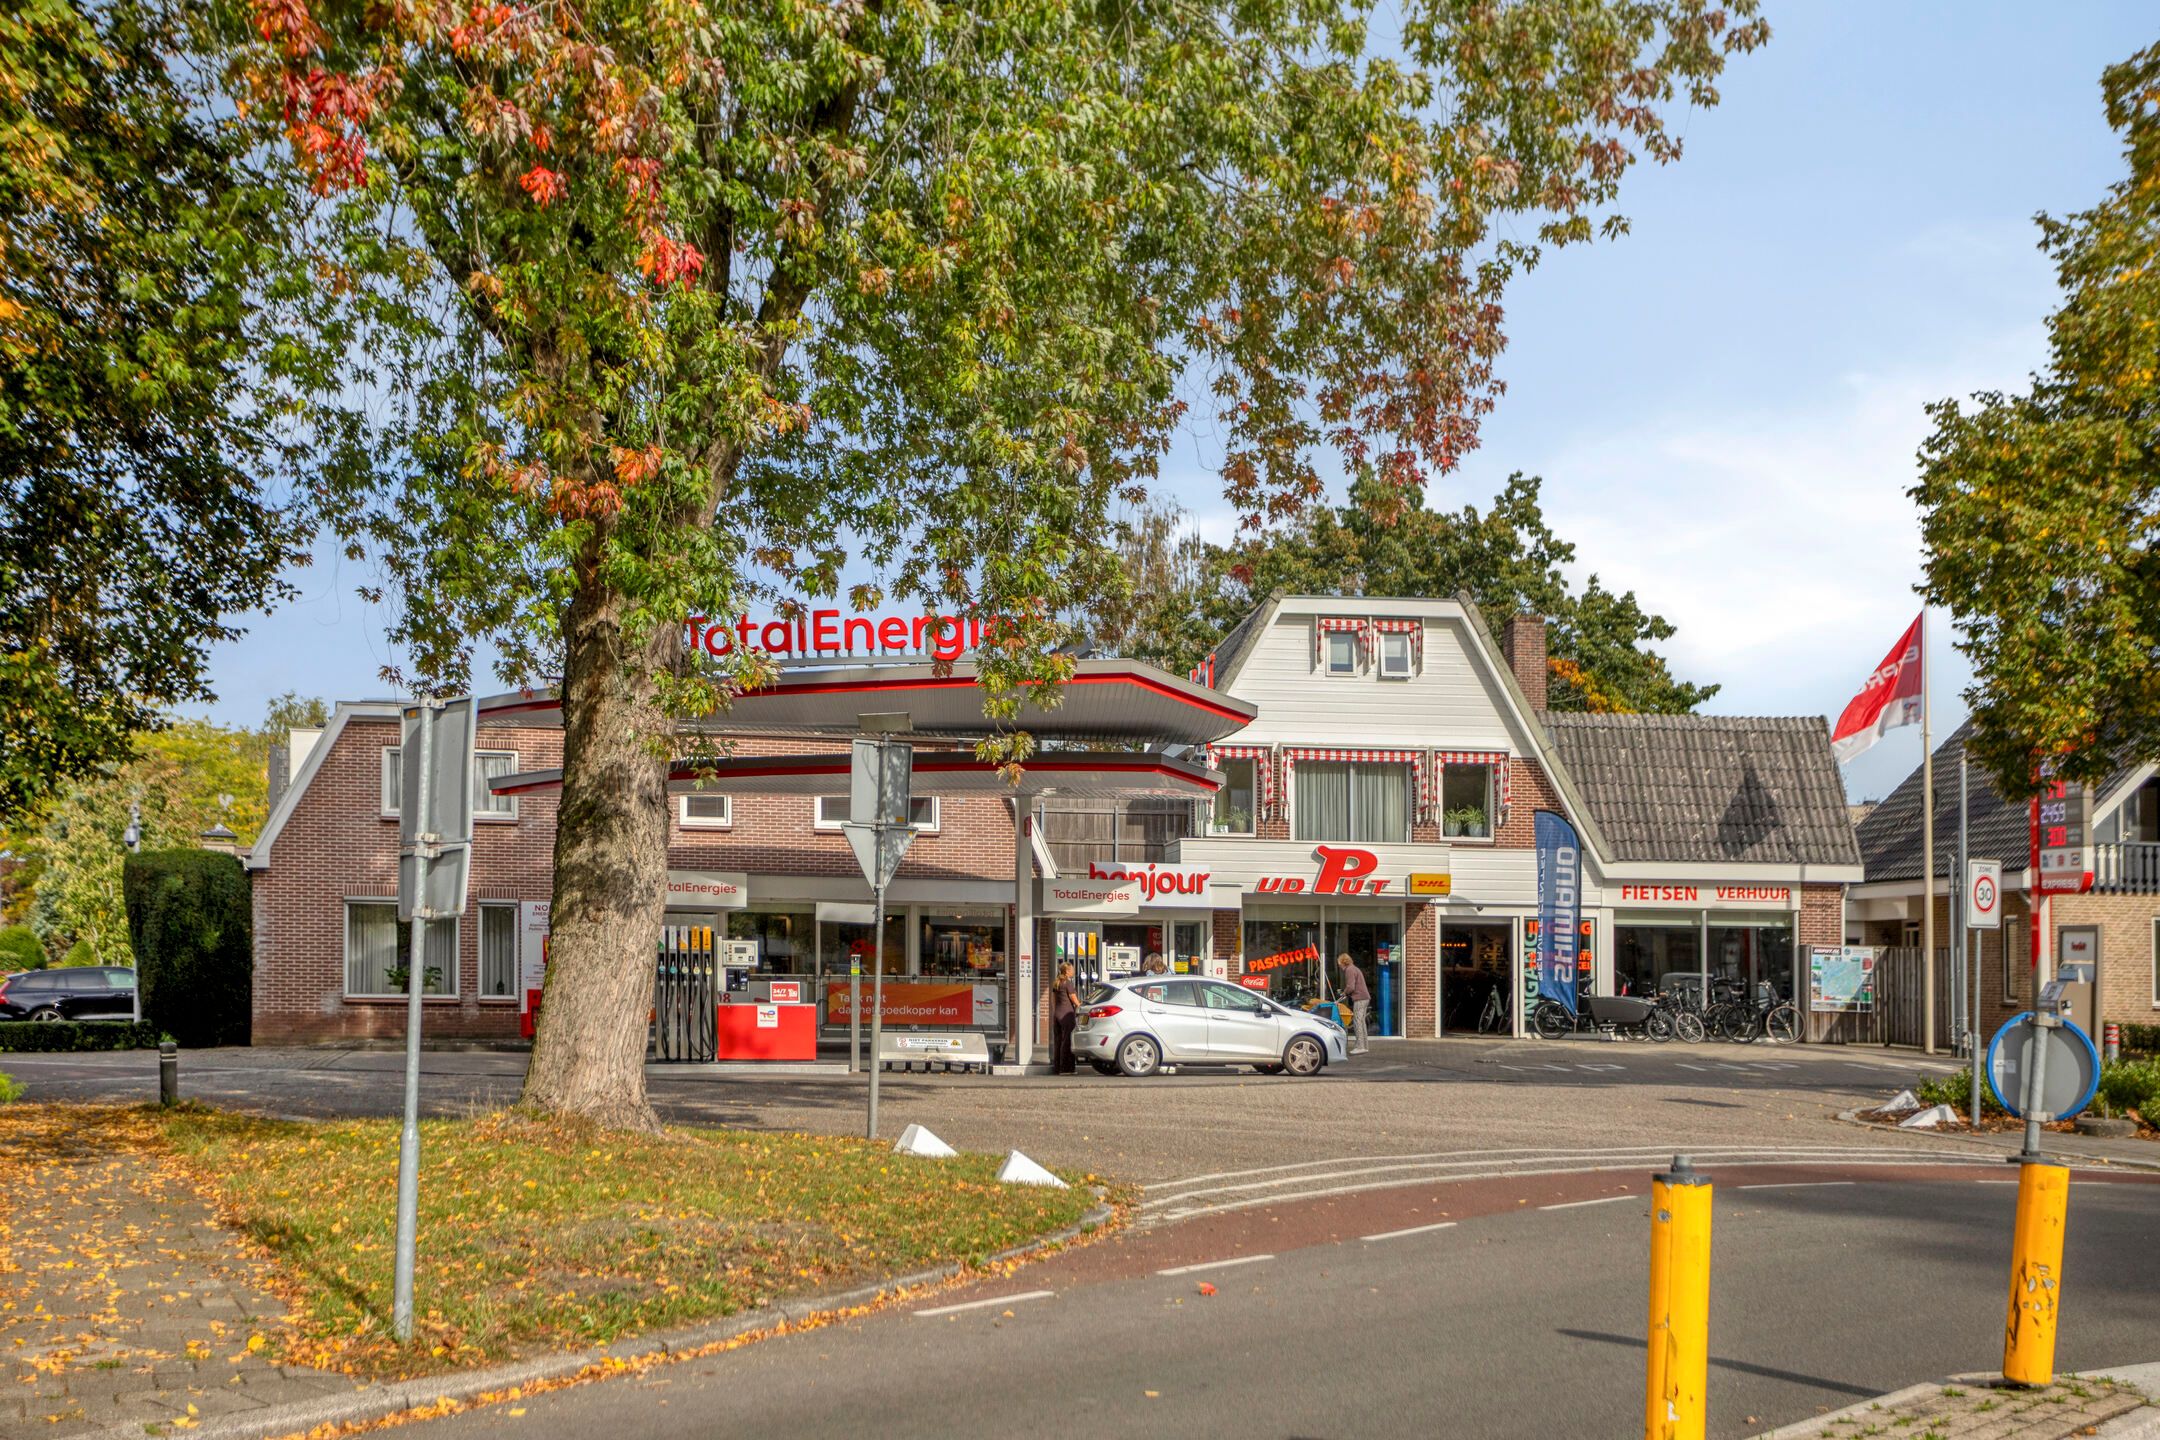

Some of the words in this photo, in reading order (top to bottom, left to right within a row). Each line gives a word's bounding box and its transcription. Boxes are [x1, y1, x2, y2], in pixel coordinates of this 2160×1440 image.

[667, 882, 736, 896] talEnergies
[1416, 880, 1447, 888] DHL
[2041, 879, 2080, 890] EXPRESS
[1053, 889, 1130, 902] TotalEnergies
[1622, 885, 1697, 901] FIETSEN
[1716, 886, 1791, 900] VERHUUR
[1978, 887, 1992, 901] 30
[838, 994, 863, 1003] Tak
[866, 994, 886, 1003] nit
[880, 1006, 936, 1017] goedkoper
[939, 1006, 958, 1015] kan
